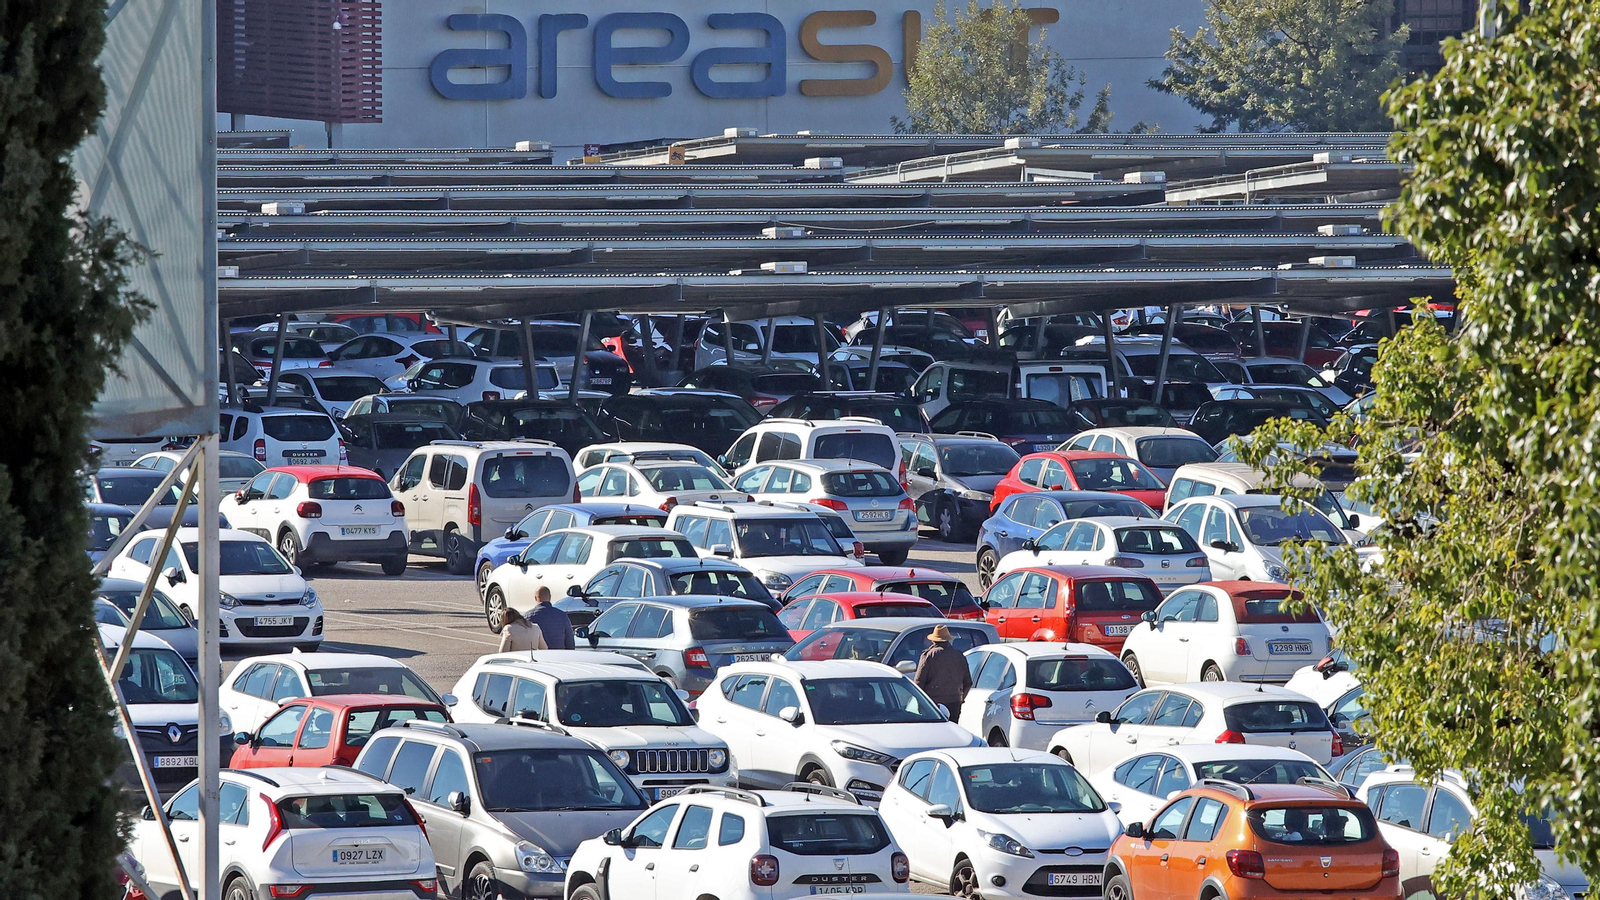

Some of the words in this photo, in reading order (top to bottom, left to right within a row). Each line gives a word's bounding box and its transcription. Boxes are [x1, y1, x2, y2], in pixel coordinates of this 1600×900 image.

[259, 617, 277, 625] 4755
[160, 758, 182, 766] 8892
[184, 758, 198, 766] KBL
[340, 851, 364, 860] 0927
[366, 850, 383, 860] LZX
[1054, 875, 1078, 884] 6749
[1082, 875, 1100, 884] HBN
